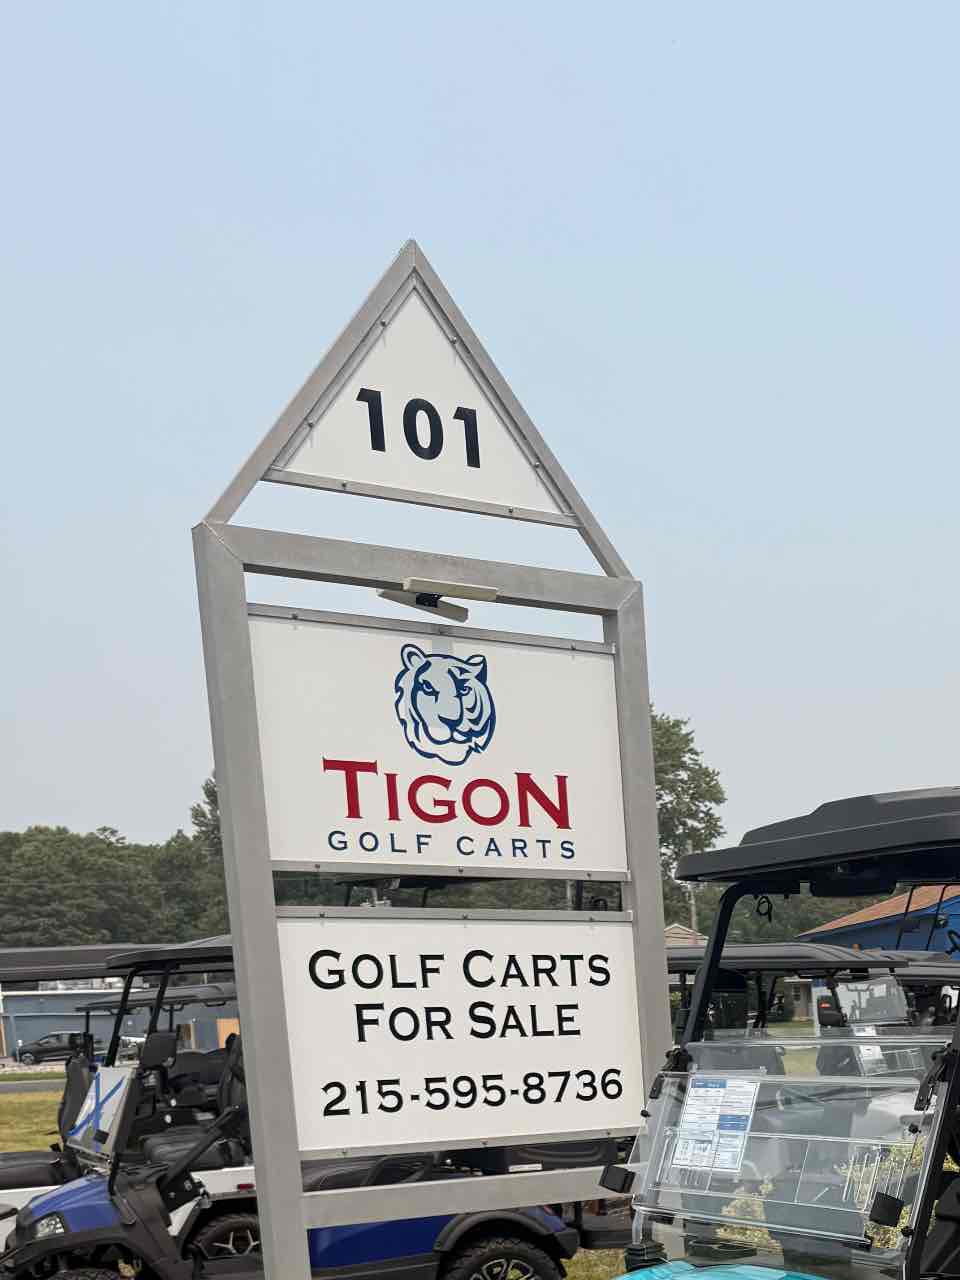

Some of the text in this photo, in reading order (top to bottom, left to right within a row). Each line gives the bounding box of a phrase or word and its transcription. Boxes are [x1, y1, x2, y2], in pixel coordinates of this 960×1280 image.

[356, 387, 481, 469] 101
[322, 757, 573, 831] TIGON
[327, 830, 577, 860] GOLF CARTS
[308, 949, 611, 990] GOLF CARTS
[354, 1001, 581, 1043] FOR SALE
[321, 1068, 624, 1117] 215-595-8736
